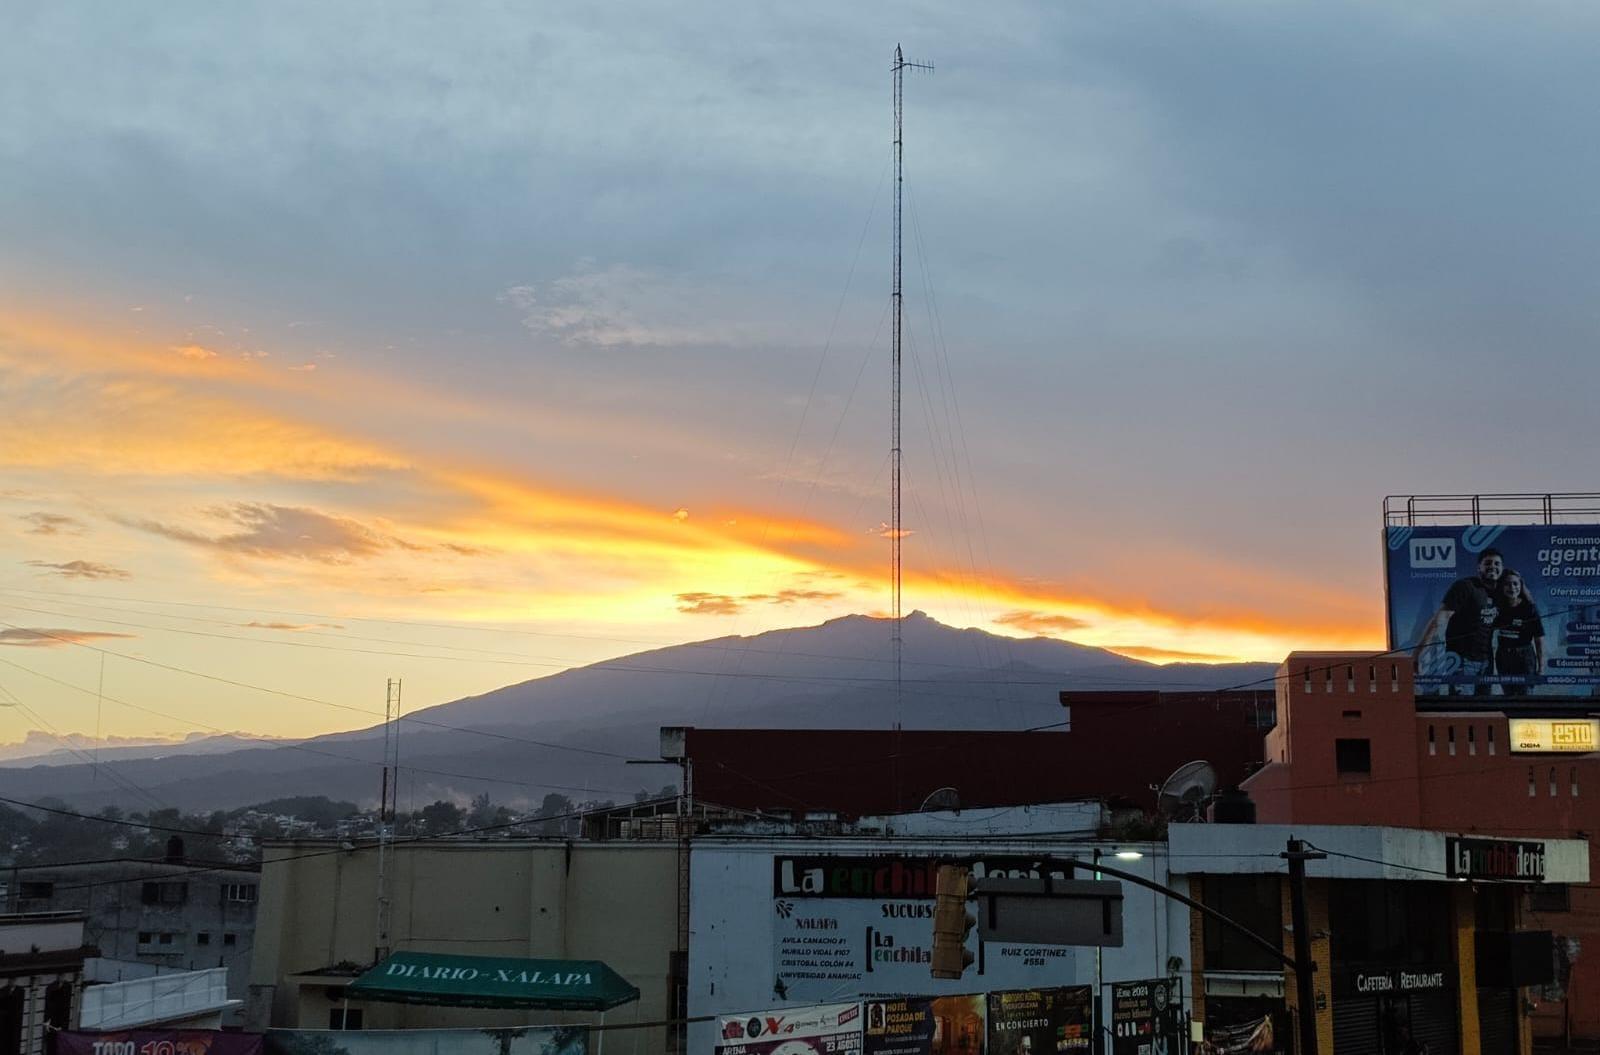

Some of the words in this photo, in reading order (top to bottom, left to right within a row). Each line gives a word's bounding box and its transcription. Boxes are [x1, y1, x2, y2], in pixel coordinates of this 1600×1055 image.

[1415, 546, 1450, 561] IUV
[1541, 565, 1561, 576] de
[1454, 841, 1471, 877] La
[782, 859, 825, 894] La
[882, 903, 937, 918] SUCURS
[796, 919, 839, 930] XALAPA
[875, 931, 894, 948] La
[875, 947, 933, 964] enchila
[1001, 948, 1022, 957] RUIZ
[1023, 948, 1067, 957] CORTINEZ
[995, 1022, 1005, 1031] EN
[1006, 1018, 1049, 1030] CONCIERTO
